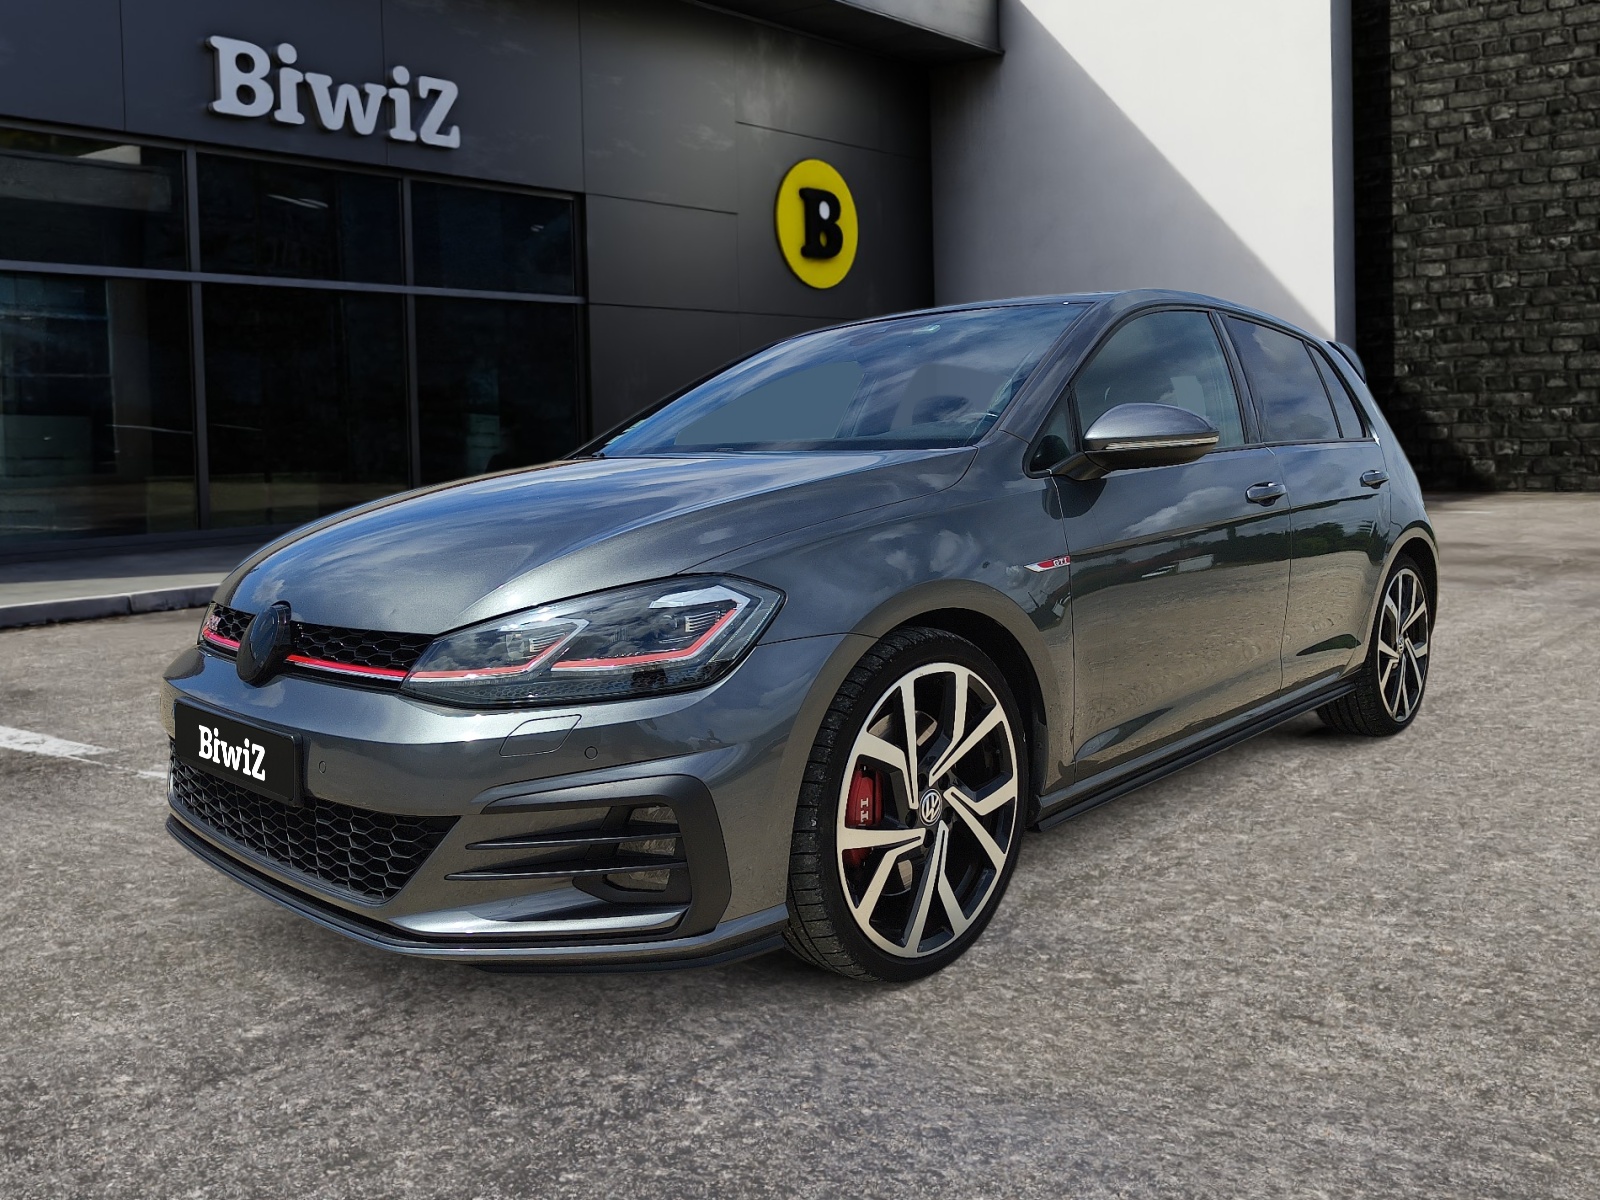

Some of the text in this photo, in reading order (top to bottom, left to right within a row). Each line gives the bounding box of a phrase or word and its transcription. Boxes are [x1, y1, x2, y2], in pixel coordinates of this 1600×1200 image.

[207, 35, 461, 148] BiwiZ
[798, 187, 843, 259] B
[1053, 557, 1067, 567] GTI
[198, 724, 266, 781] BiwiZ
